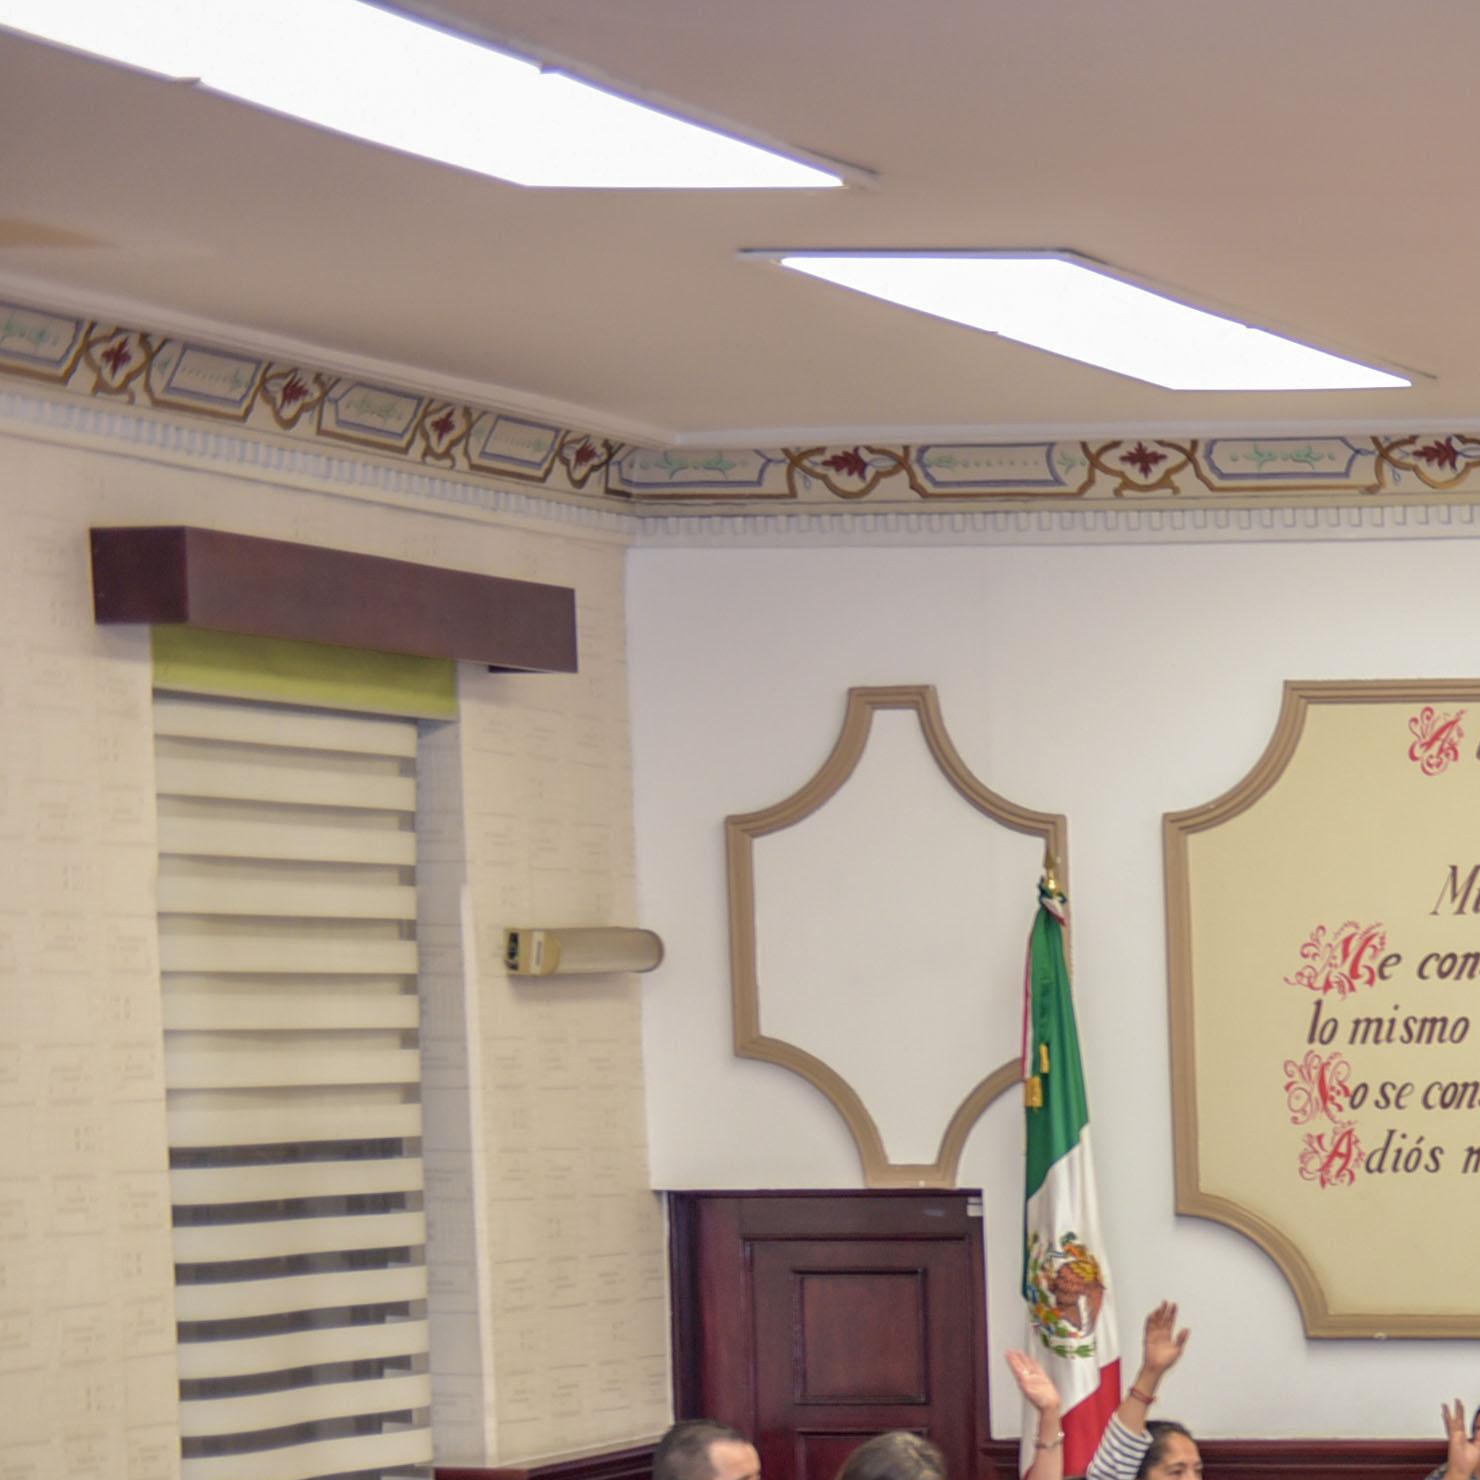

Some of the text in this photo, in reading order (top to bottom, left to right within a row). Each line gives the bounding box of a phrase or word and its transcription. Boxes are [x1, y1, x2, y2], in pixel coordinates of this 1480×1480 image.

[1307, 999, 1338, 1045] lo
[1348, 1004, 1470, 1045] mismo
[1374, 1081, 1414, 1110] se
[1299, 1126, 1444, 1189] Adiós
